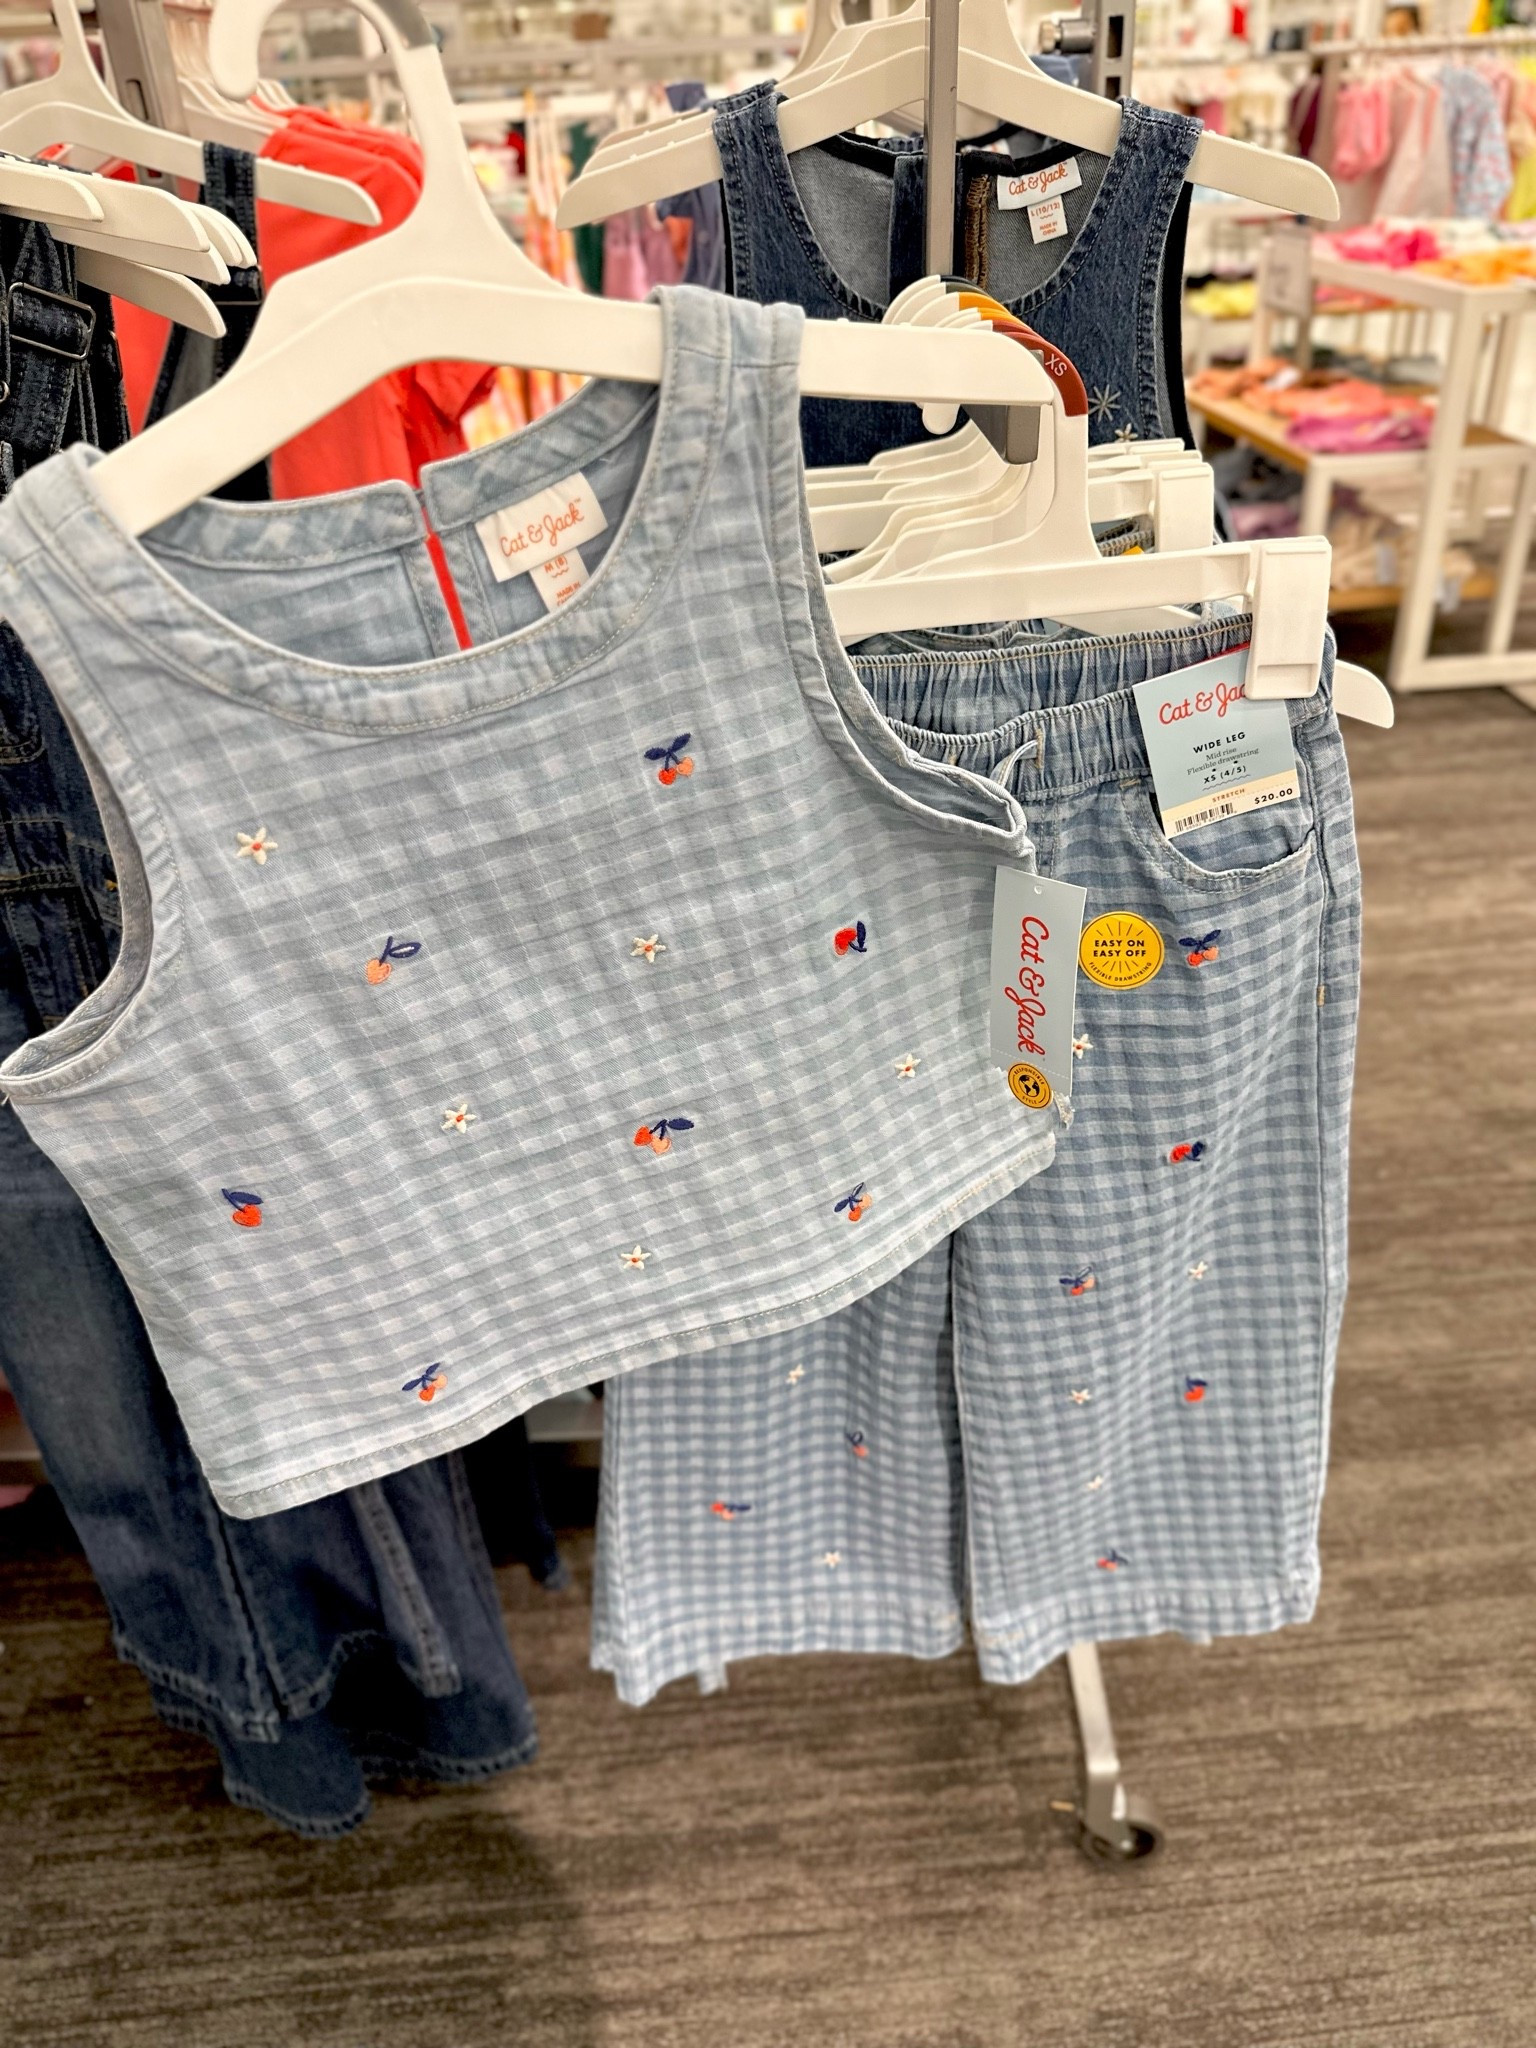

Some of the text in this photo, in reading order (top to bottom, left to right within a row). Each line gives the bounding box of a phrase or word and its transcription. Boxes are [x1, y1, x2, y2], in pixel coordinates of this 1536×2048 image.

[1008, 163, 1068, 195] Cat & Jack
[1045, 354, 1068, 377] XS
[500, 502, 585, 558] Cat & Jack
[544, 562, 554, 573] M
[1159, 682, 1246, 725] Cat & Jac
[1193, 731, 1246, 754] WIDE LEG
[1187, 747, 1260, 776] Flexible drawstring
[1205, 746, 1237, 762] Mid rise
[1203, 765, 1247, 785] XS (4/5)
[1212, 788, 1246, 803] STRETCH
[1254, 787, 1294, 805] $20.00
[1093, 949, 1146, 957] EASY OFF
[1094, 939, 1145, 947] EASY ON
[1089, 961, 1152, 982] FLEXIBLE DRAWSTRING
[1004, 916, 1049, 1056] Cat & Jack
